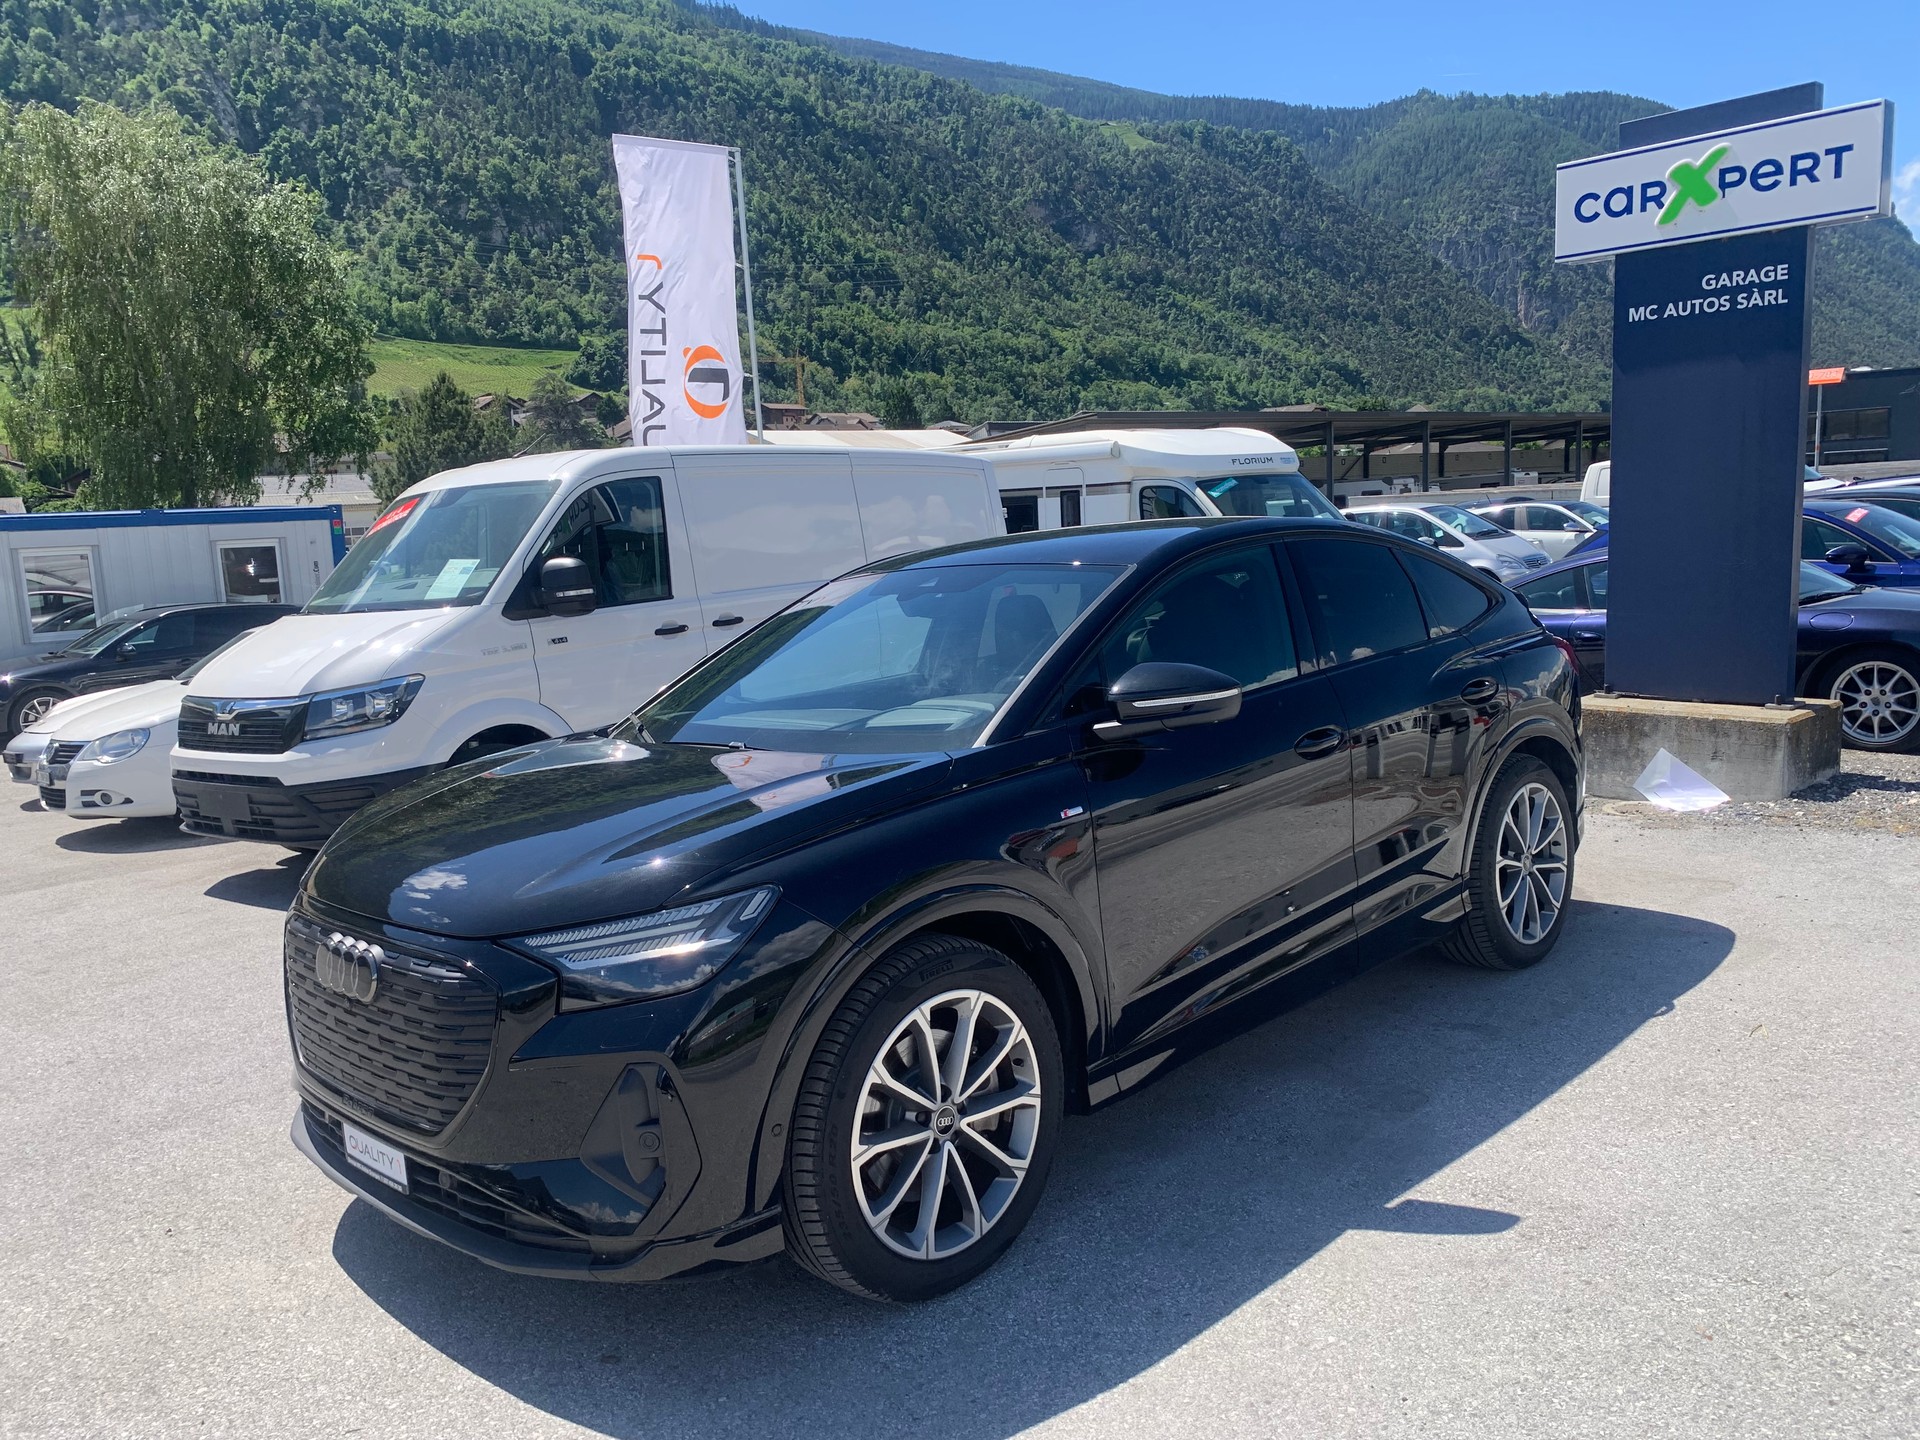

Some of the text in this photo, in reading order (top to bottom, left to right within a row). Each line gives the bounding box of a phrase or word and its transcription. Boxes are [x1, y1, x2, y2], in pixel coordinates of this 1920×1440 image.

[1701, 264, 1789, 290] GARAGE
[1628, 288, 1789, 322] MC AUTOS SÀRL
[1231, 457, 1274, 465] FLORIUM
[208, 722, 240, 736] MAN
[919, 960, 954, 981] PIRELLI
[348, 1135, 394, 1170] QUALITY
